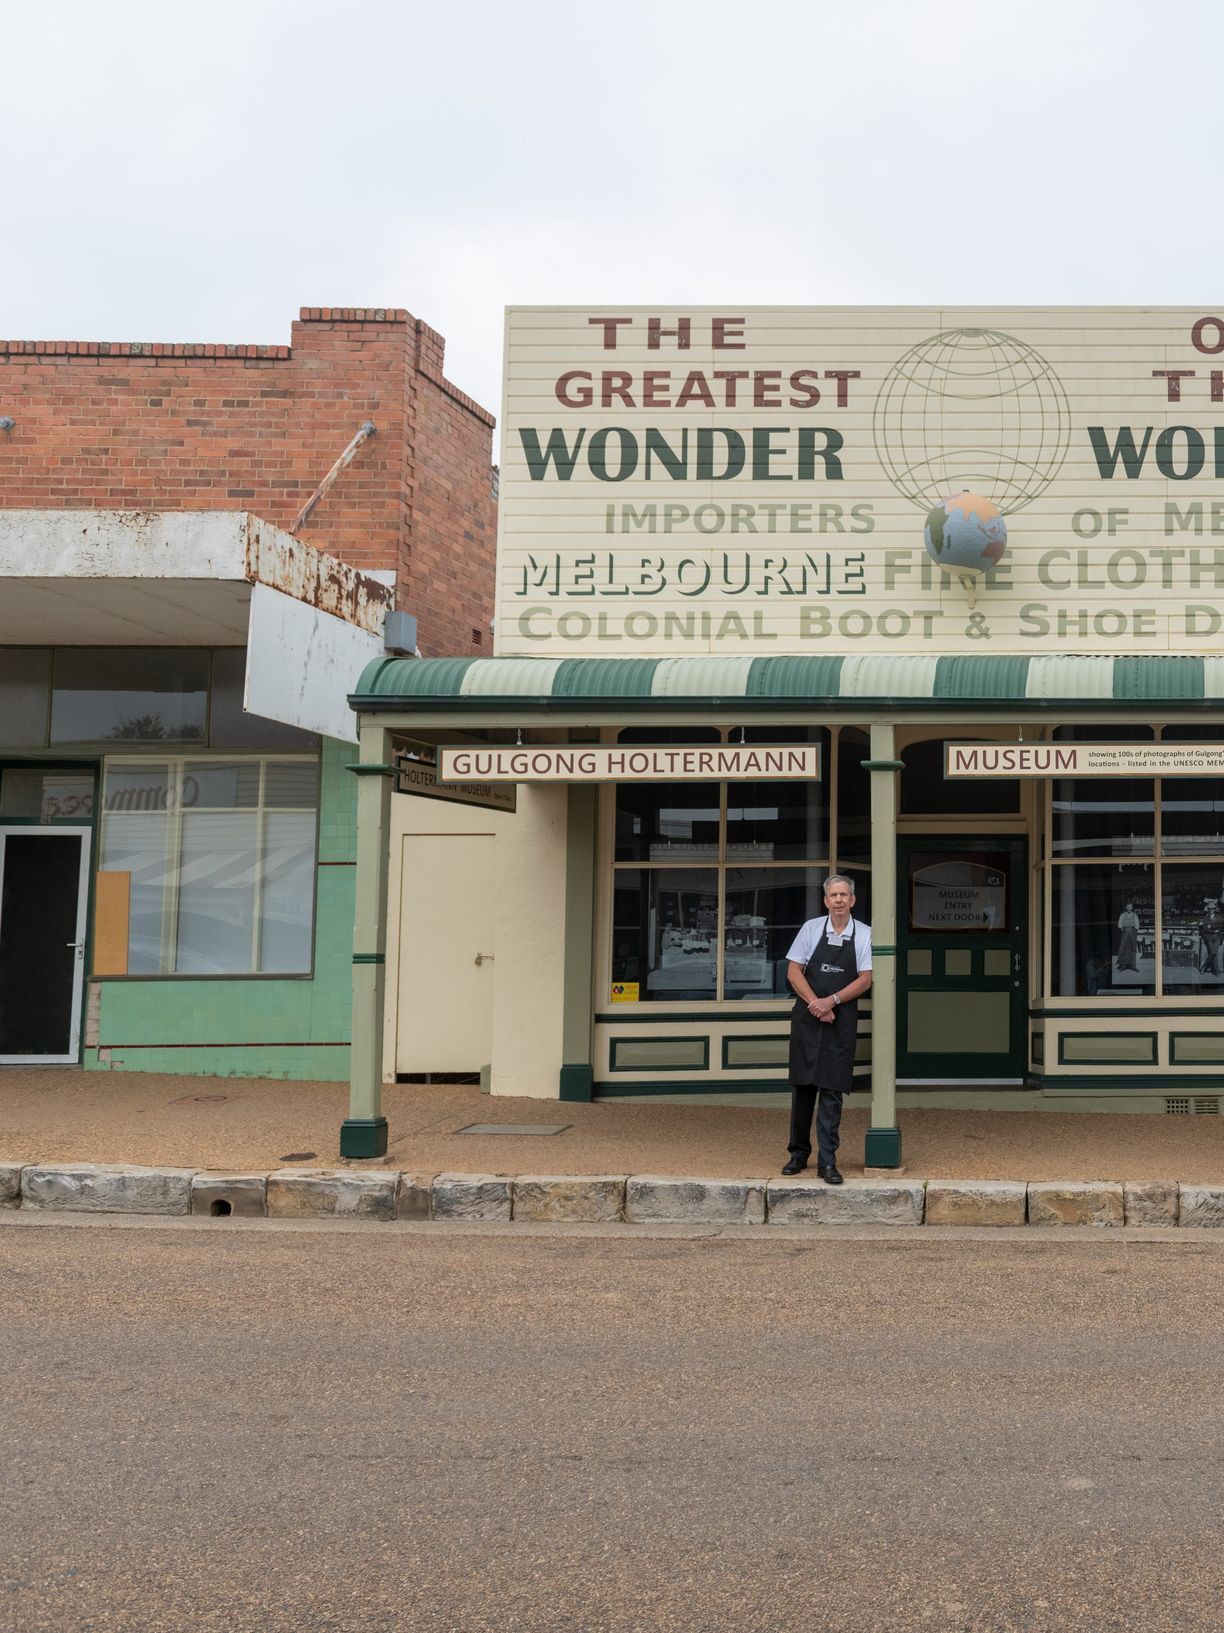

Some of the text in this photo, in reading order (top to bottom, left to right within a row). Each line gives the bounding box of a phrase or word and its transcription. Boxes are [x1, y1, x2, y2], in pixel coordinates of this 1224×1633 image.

[588, 318, 746, 350] THE
[554, 370, 861, 408] GREATEST
[518, 426, 844, 482] WONDER
[604, 503, 876, 534] IMPORTERS
[1071, 507, 1129, 538] OF
[514, 552, 867, 596] MELBOURNE
[517, 606, 778, 641] COLONIAL
[799, 605, 944, 640] BOOT
[964, 611, 992, 640] &
[1018, 602, 1157, 638] SHOE
[452, 751, 807, 775] GULGONG HOLTERMANN
[956, 749, 1078, 770] MUSEUM
[1088, 750, 1117, 759] showing
[1118, 750, 1134, 758] 100s
[1144, 749, 1185, 759] photographs
[1187, 749, 1194, 757] of
[1173, 759, 1204, 767] UNESCO
[939, 890, 979, 899] MUSEUM
[944, 901, 972, 909] ENTRY
[928, 913, 981, 921] NEXT DOOR
